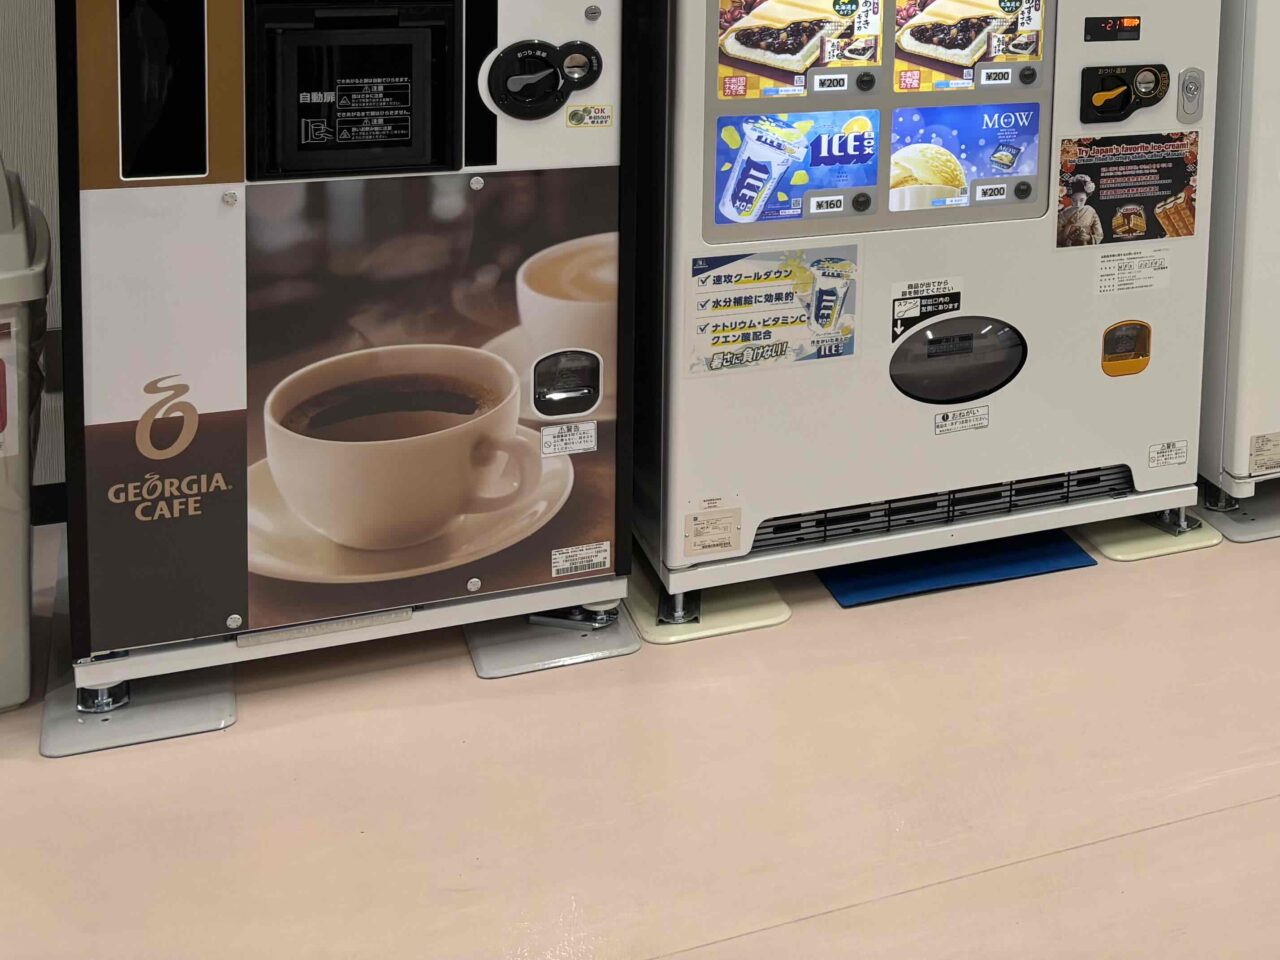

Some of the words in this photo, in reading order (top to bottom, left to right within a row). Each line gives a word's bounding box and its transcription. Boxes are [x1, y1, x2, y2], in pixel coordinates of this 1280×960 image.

[818, 77, 845, 88] ¥200
[986, 71, 1009, 81] ¥200
[300, 92, 336, 104] 自動扉
[982, 112, 1034, 130] MOW
[821, 131, 860, 157] ICE
[1077, 147, 1088, 157] Try
[1091, 145, 1120, 157] Japan's
[1121, 143, 1149, 154] favorite
[981, 186, 1005, 197] ¥200
[816, 199, 842, 211] ¥160
[711, 269, 793, 286] 速攻クールダウン
[711, 330, 773, 345] クエン酸配合
[107, 472, 227, 504] GEORGIA
[134, 496, 202, 522] CAFE
